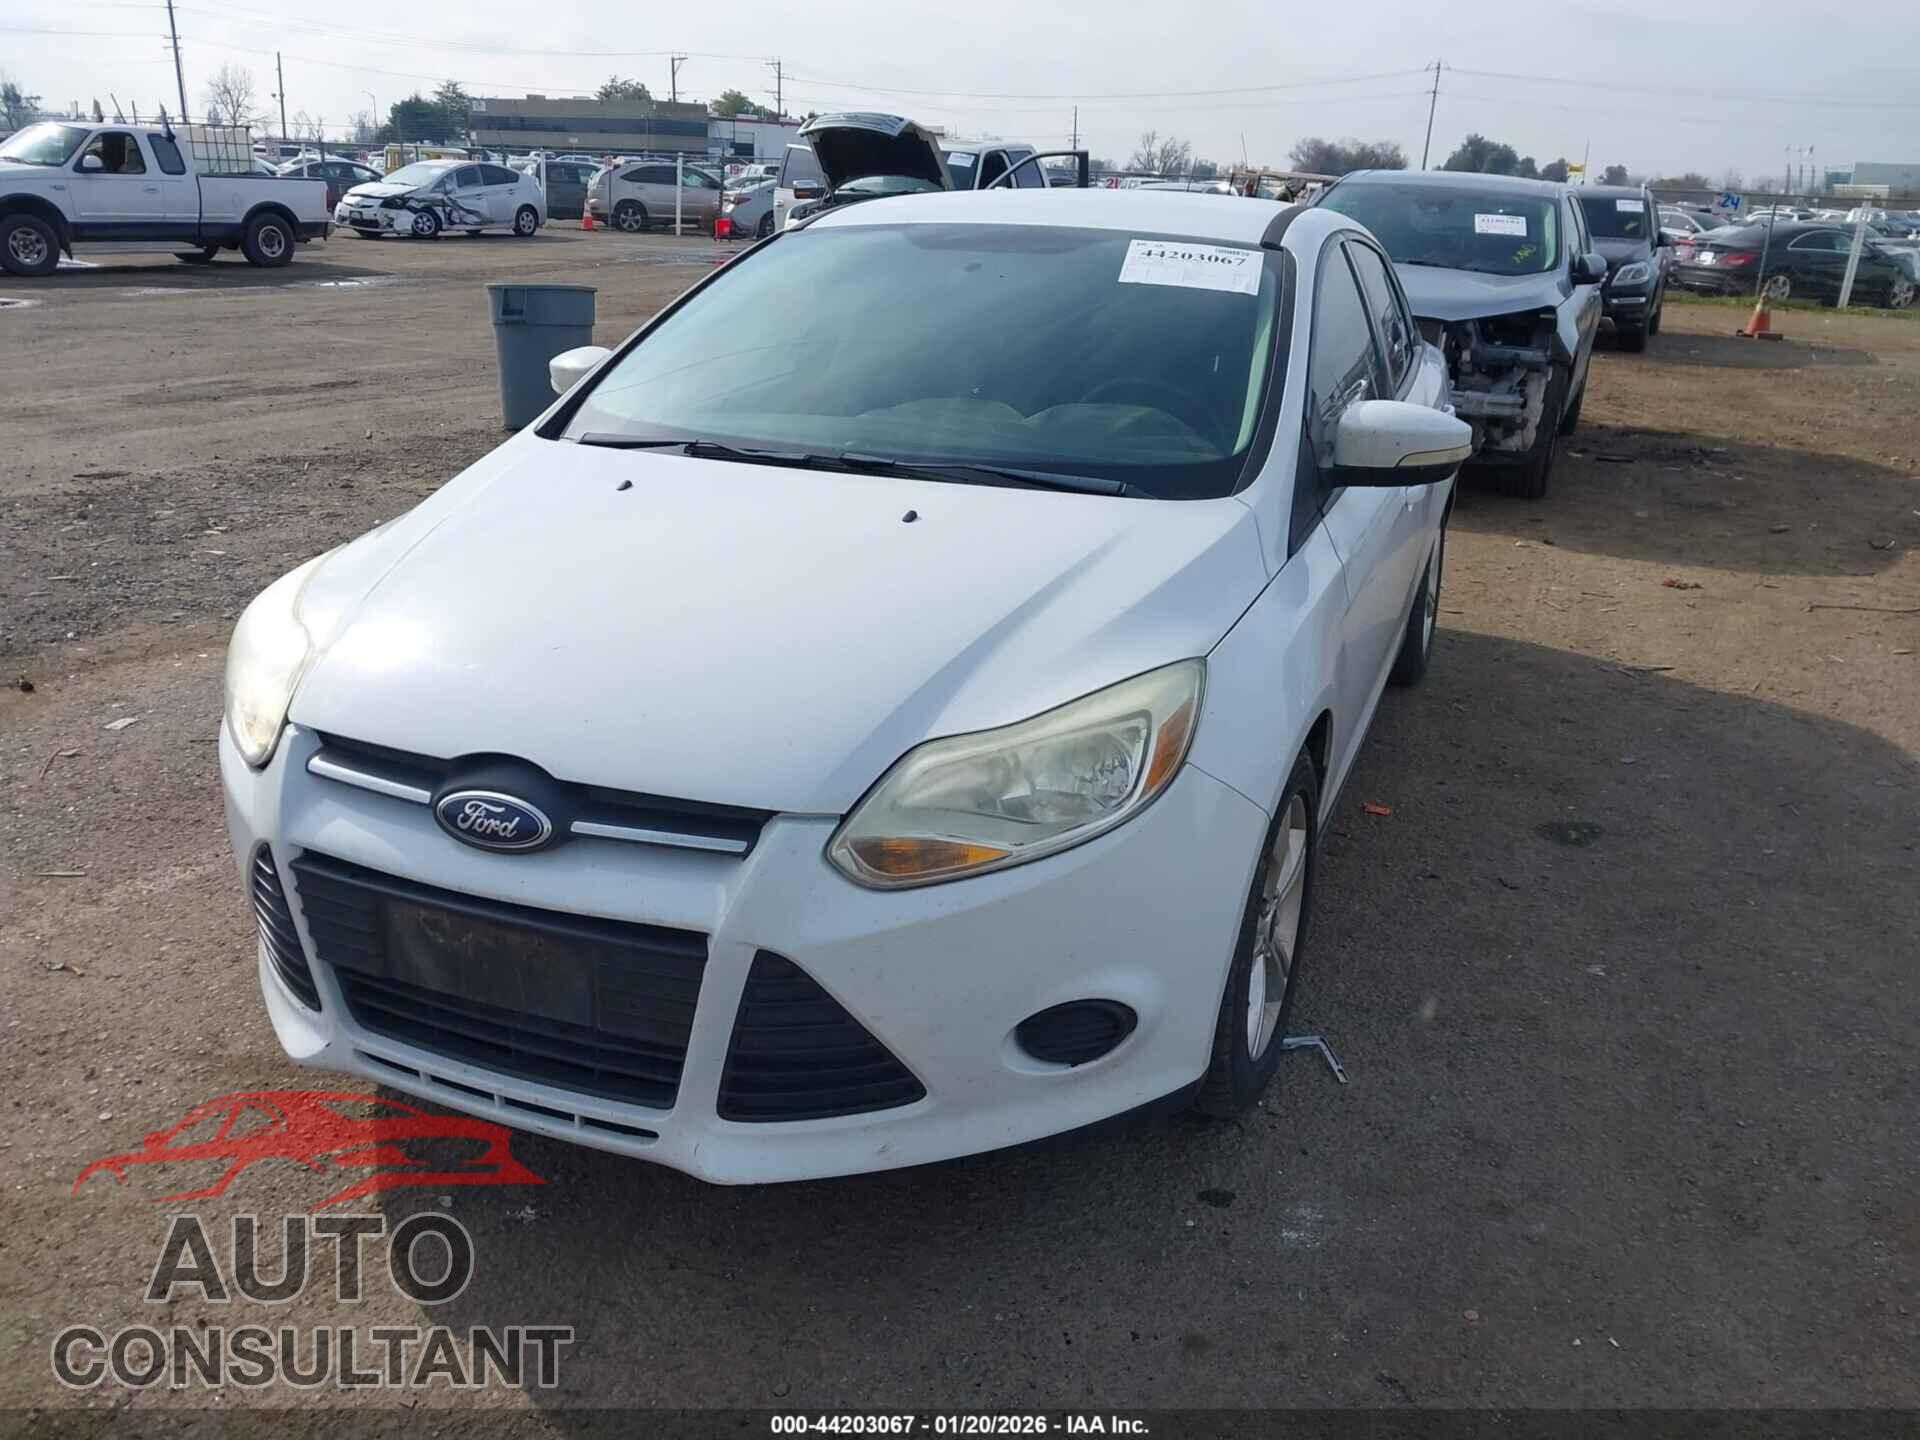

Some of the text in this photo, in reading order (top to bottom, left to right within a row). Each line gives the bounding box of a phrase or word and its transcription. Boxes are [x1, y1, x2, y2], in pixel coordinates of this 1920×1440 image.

[1105, 178, 1118, 189] 21
[1721, 192, 1740, 210] 24
[1141, 249, 1246, 266] 44203067
[457, 800, 520, 838] Ford
